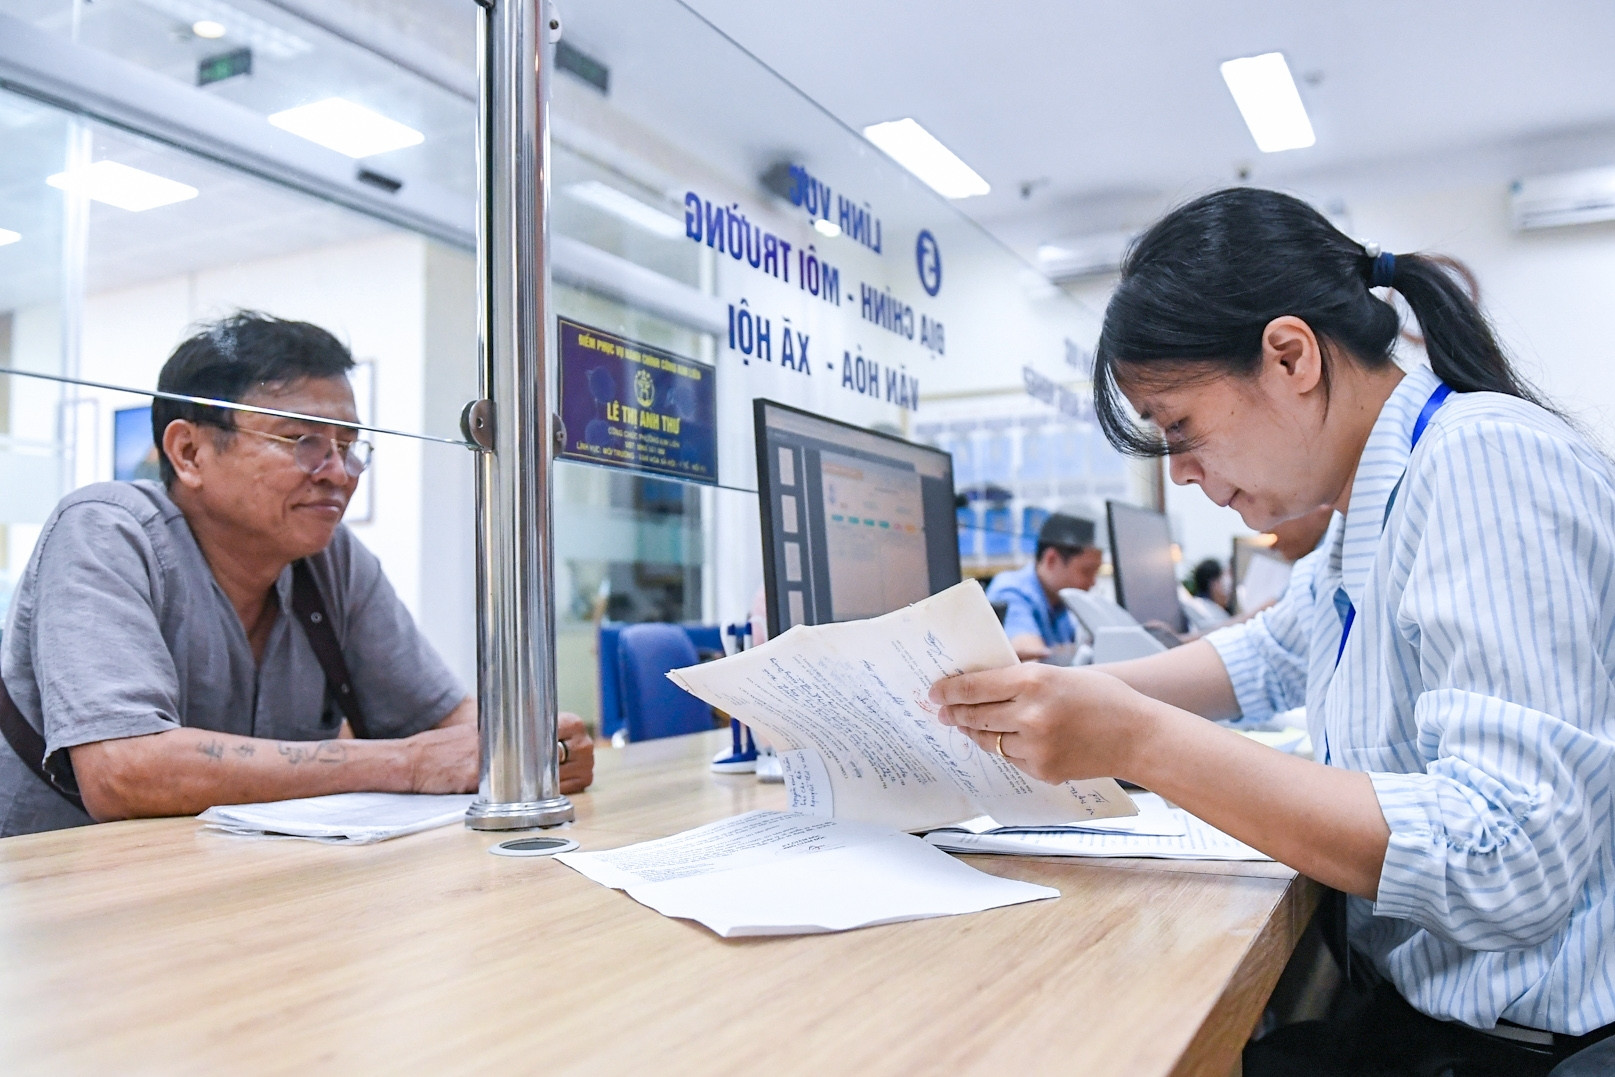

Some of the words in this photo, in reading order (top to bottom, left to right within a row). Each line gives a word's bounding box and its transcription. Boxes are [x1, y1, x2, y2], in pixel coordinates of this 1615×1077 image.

[607, 400, 620, 422] LÊ
[622, 407, 638, 429] THỊ
[640, 411, 660, 430] ANH
[662, 415, 680, 434] THƯ
